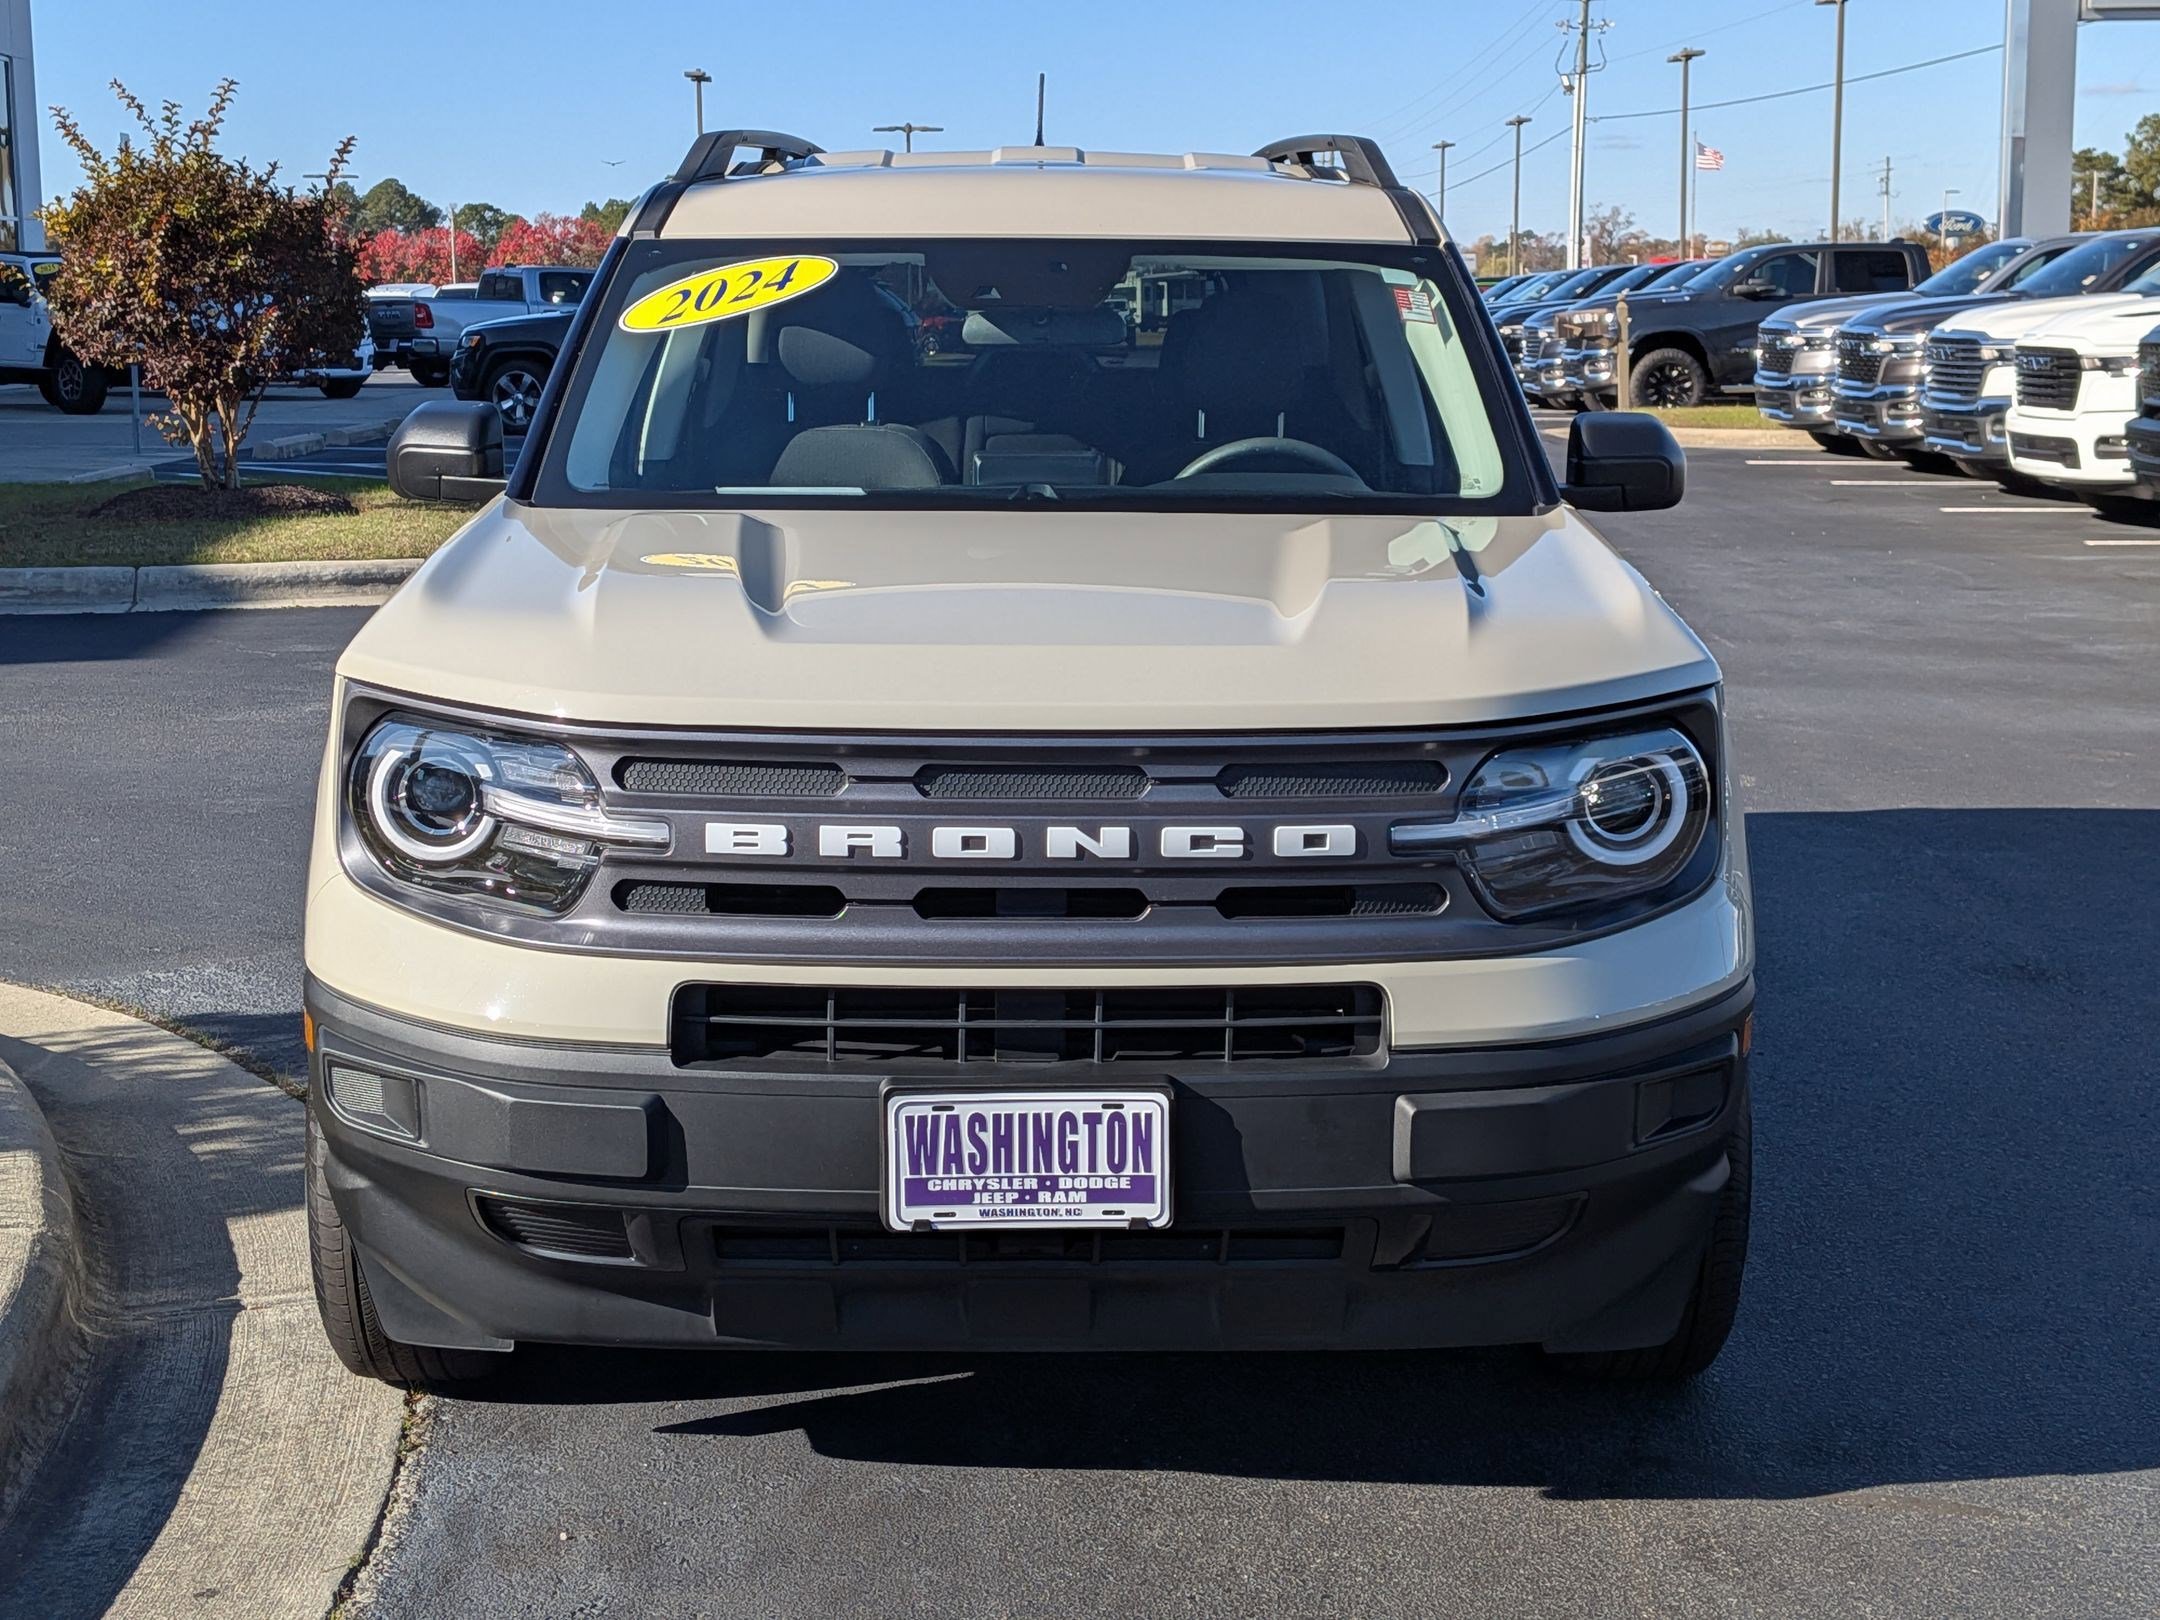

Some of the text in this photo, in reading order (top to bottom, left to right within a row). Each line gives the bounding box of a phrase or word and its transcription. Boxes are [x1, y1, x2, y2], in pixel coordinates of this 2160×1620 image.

[1938, 216, 1975, 232] Ford
[657, 260, 800, 324] 2024
[704, 821, 1357, 859] BRONCO
[904, 1110, 1153, 1176] WASHINGTON
[927, 1176, 1131, 1191] CHRYSLER DODGE
[971, 1190, 1087, 1205] JEEP RAM
[1064, 1207, 1082, 1217] NC
